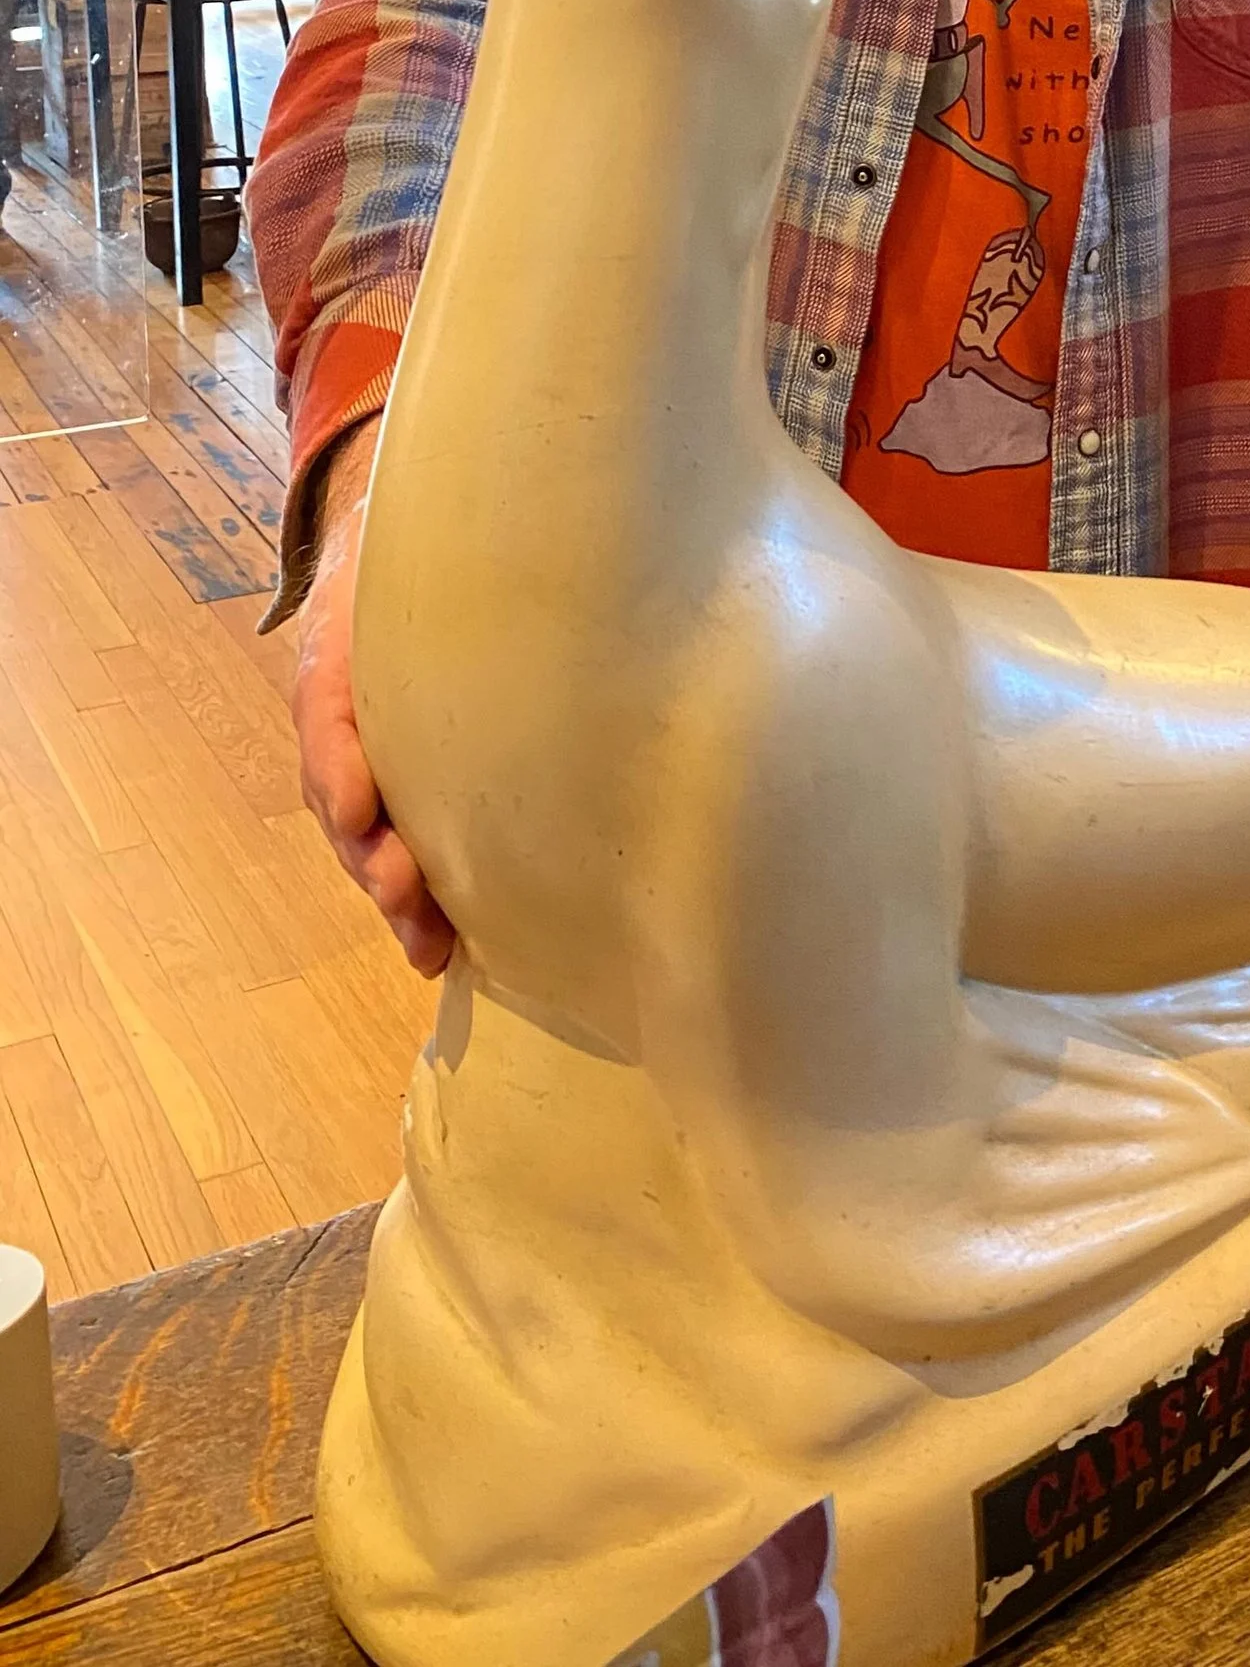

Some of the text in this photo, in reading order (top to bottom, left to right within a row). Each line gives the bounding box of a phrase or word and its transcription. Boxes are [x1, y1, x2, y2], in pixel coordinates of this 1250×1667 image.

[1029, 15, 1081, 40] Ne
[1019, 122, 1085, 146] sho
[1039, 1510, 1110, 1573] THE
